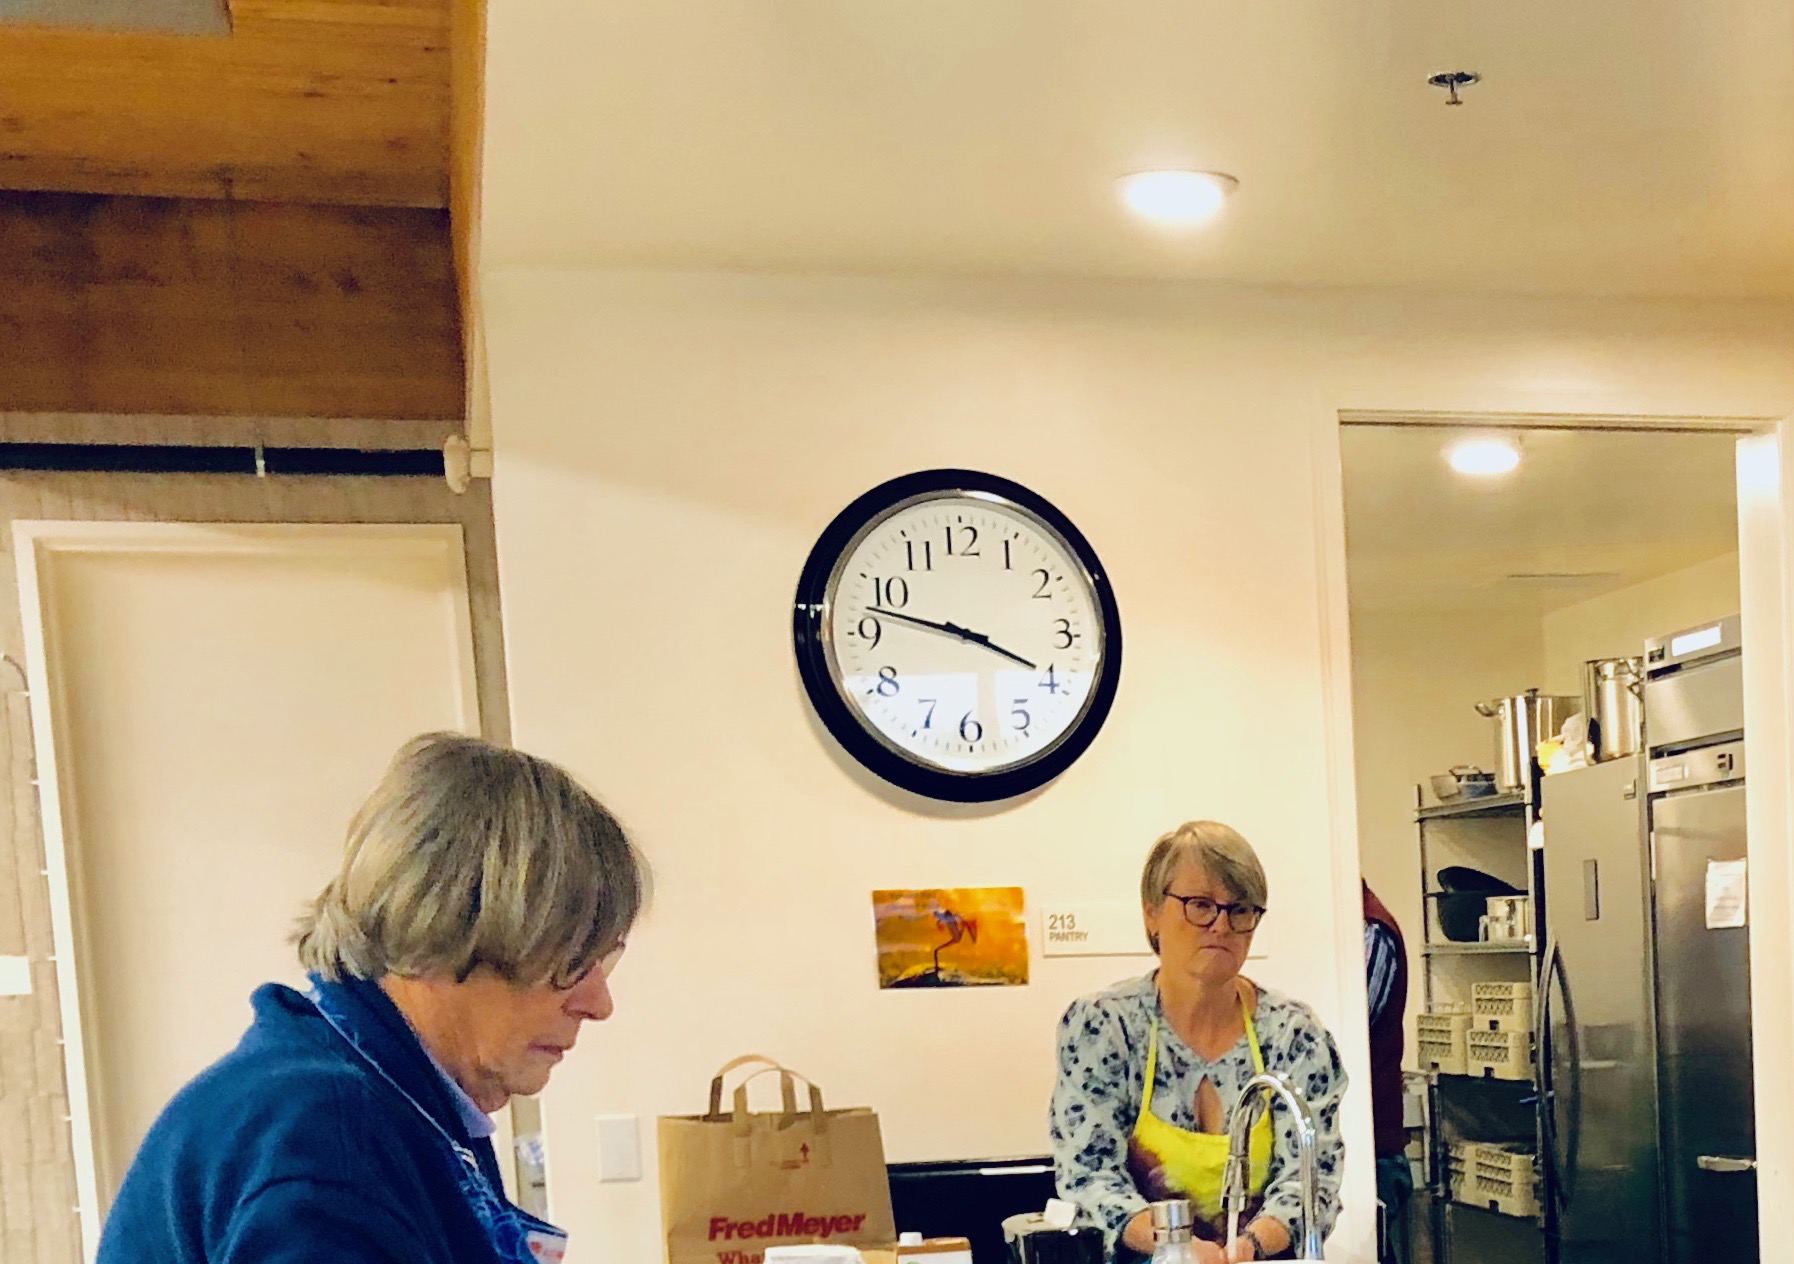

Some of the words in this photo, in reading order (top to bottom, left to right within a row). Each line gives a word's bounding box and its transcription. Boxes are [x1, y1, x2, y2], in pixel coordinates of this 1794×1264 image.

[905, 540, 934, 571] 11
[944, 526, 981, 557] 12
[1003, 539, 1013, 570] 1
[874, 576, 909, 608] 10
[1031, 569, 1053, 600] 2
[858, 617, 882, 651] 9
[1053, 618, 1074, 650] 3
[876, 666, 900, 697] 8
[1037, 663, 1060, 694] 4
[917, 698, 937, 729] 7
[959, 710, 983, 743] 6
[1011, 698, 1031, 730] 5
[1049, 914, 1076, 930] 213
[1049, 931, 1088, 942] PANTRY
